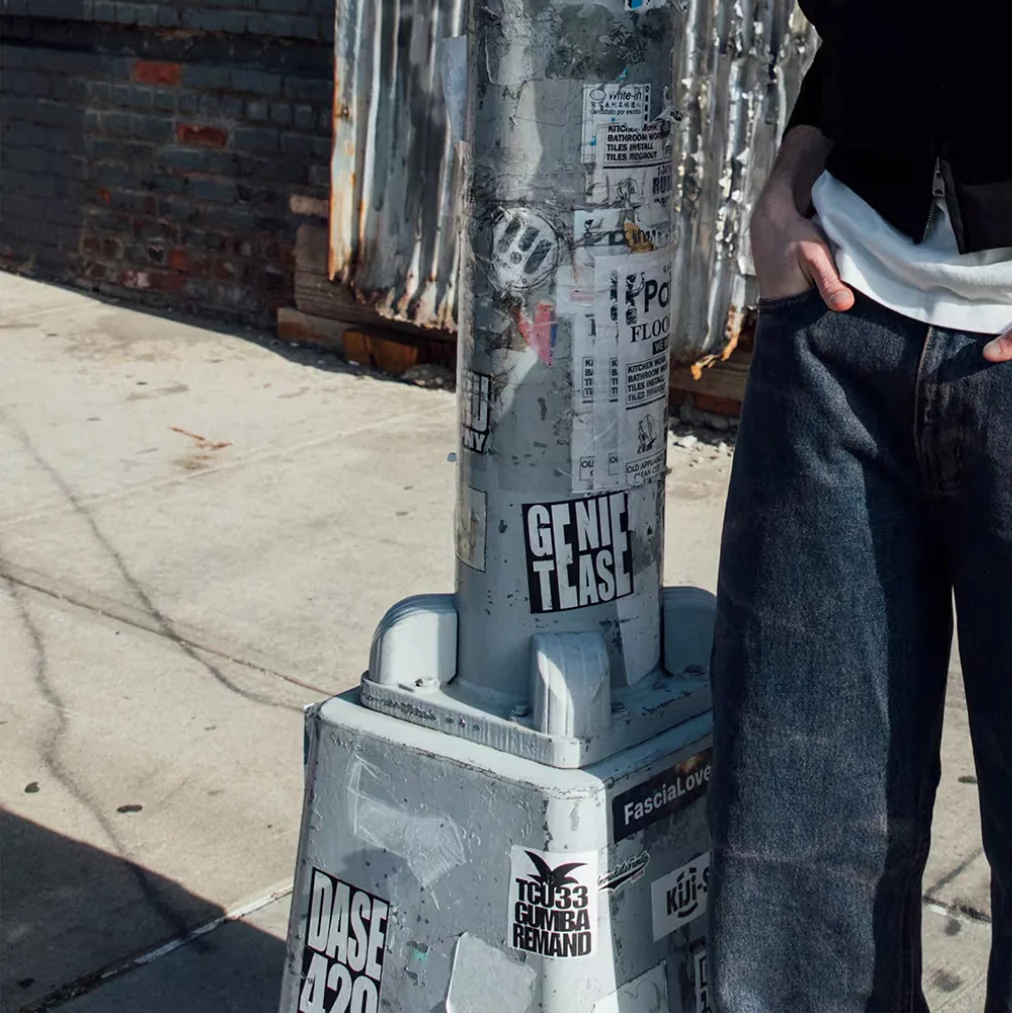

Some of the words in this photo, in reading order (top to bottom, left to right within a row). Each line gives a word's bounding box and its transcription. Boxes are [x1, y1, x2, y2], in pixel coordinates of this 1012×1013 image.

[608, 91, 642, 100] Write-in
[607, 133, 648, 142] BATHROOM
[607, 143, 628, 152] TILES
[629, 142, 654, 151] INSTALL
[606, 152, 627, 161] TILES
[627, 360, 653, 374] KITCHEN
[627, 367, 659, 383] BATHROOM
[627, 381, 645, 392] TILES
[527, 492, 629, 559] GENIE
[532, 545, 631, 611] TEASE
[624, 762, 712, 826] FasciaLove
[514, 901, 591, 933] GUMBA
[308, 870, 388, 982] DASE
[512, 923, 592, 958] REMAND
